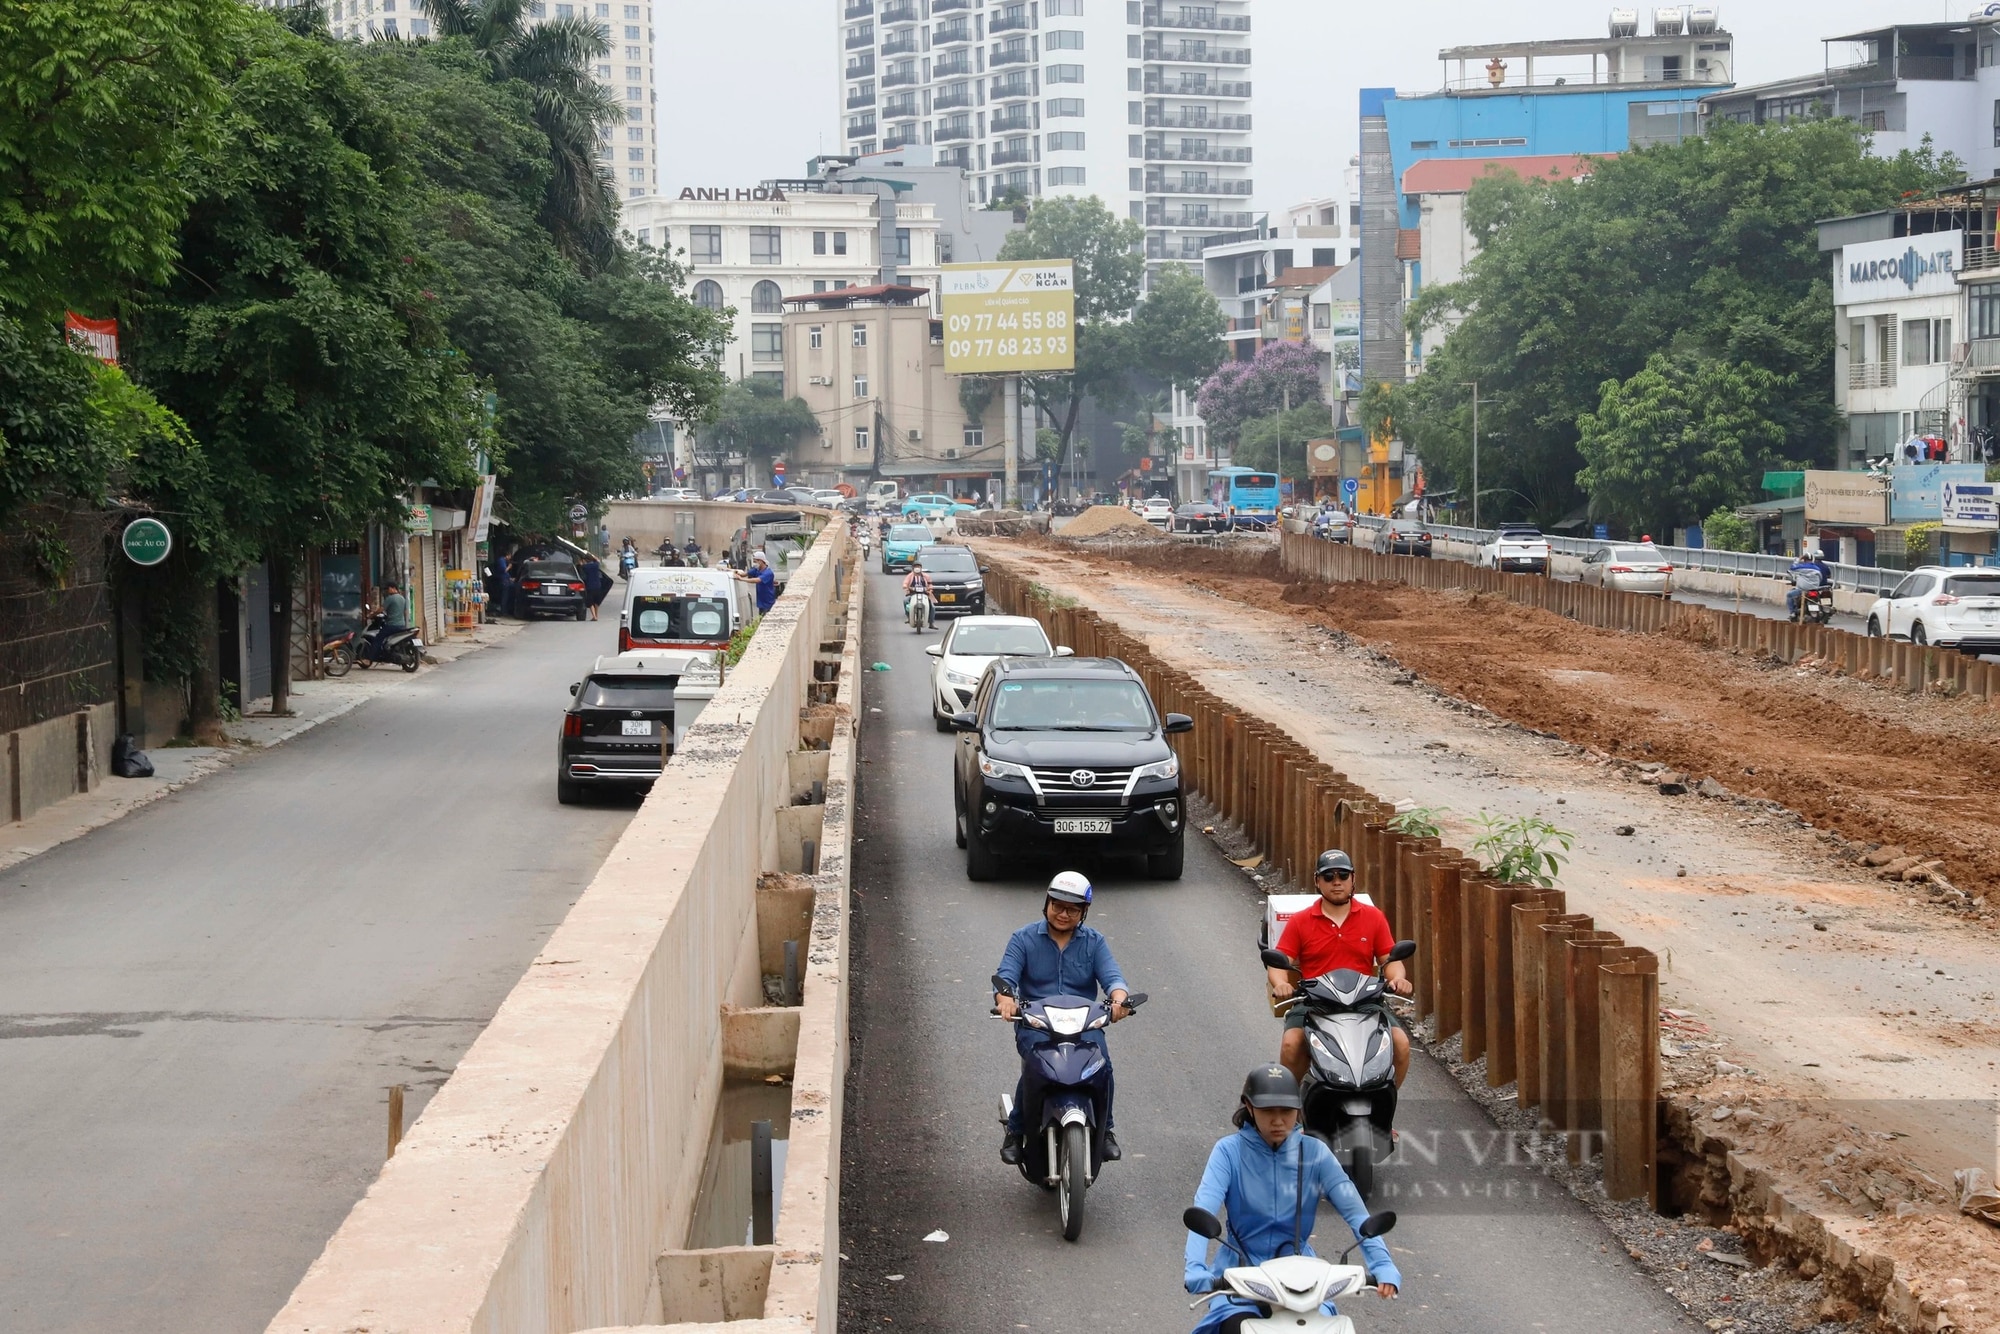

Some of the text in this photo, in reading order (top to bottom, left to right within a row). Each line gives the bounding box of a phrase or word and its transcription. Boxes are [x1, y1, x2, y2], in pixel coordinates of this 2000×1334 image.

[679, 187, 730, 201] ANH
[1036, 272, 1056, 280] KIM
[1036, 279, 1067, 287] NGAN
[949, 311, 1066, 332] 09 77 44 55 88
[949, 336, 1067, 358] 09 77 68 23 93
[1056, 821, 1111, 832] 30G-155.27
